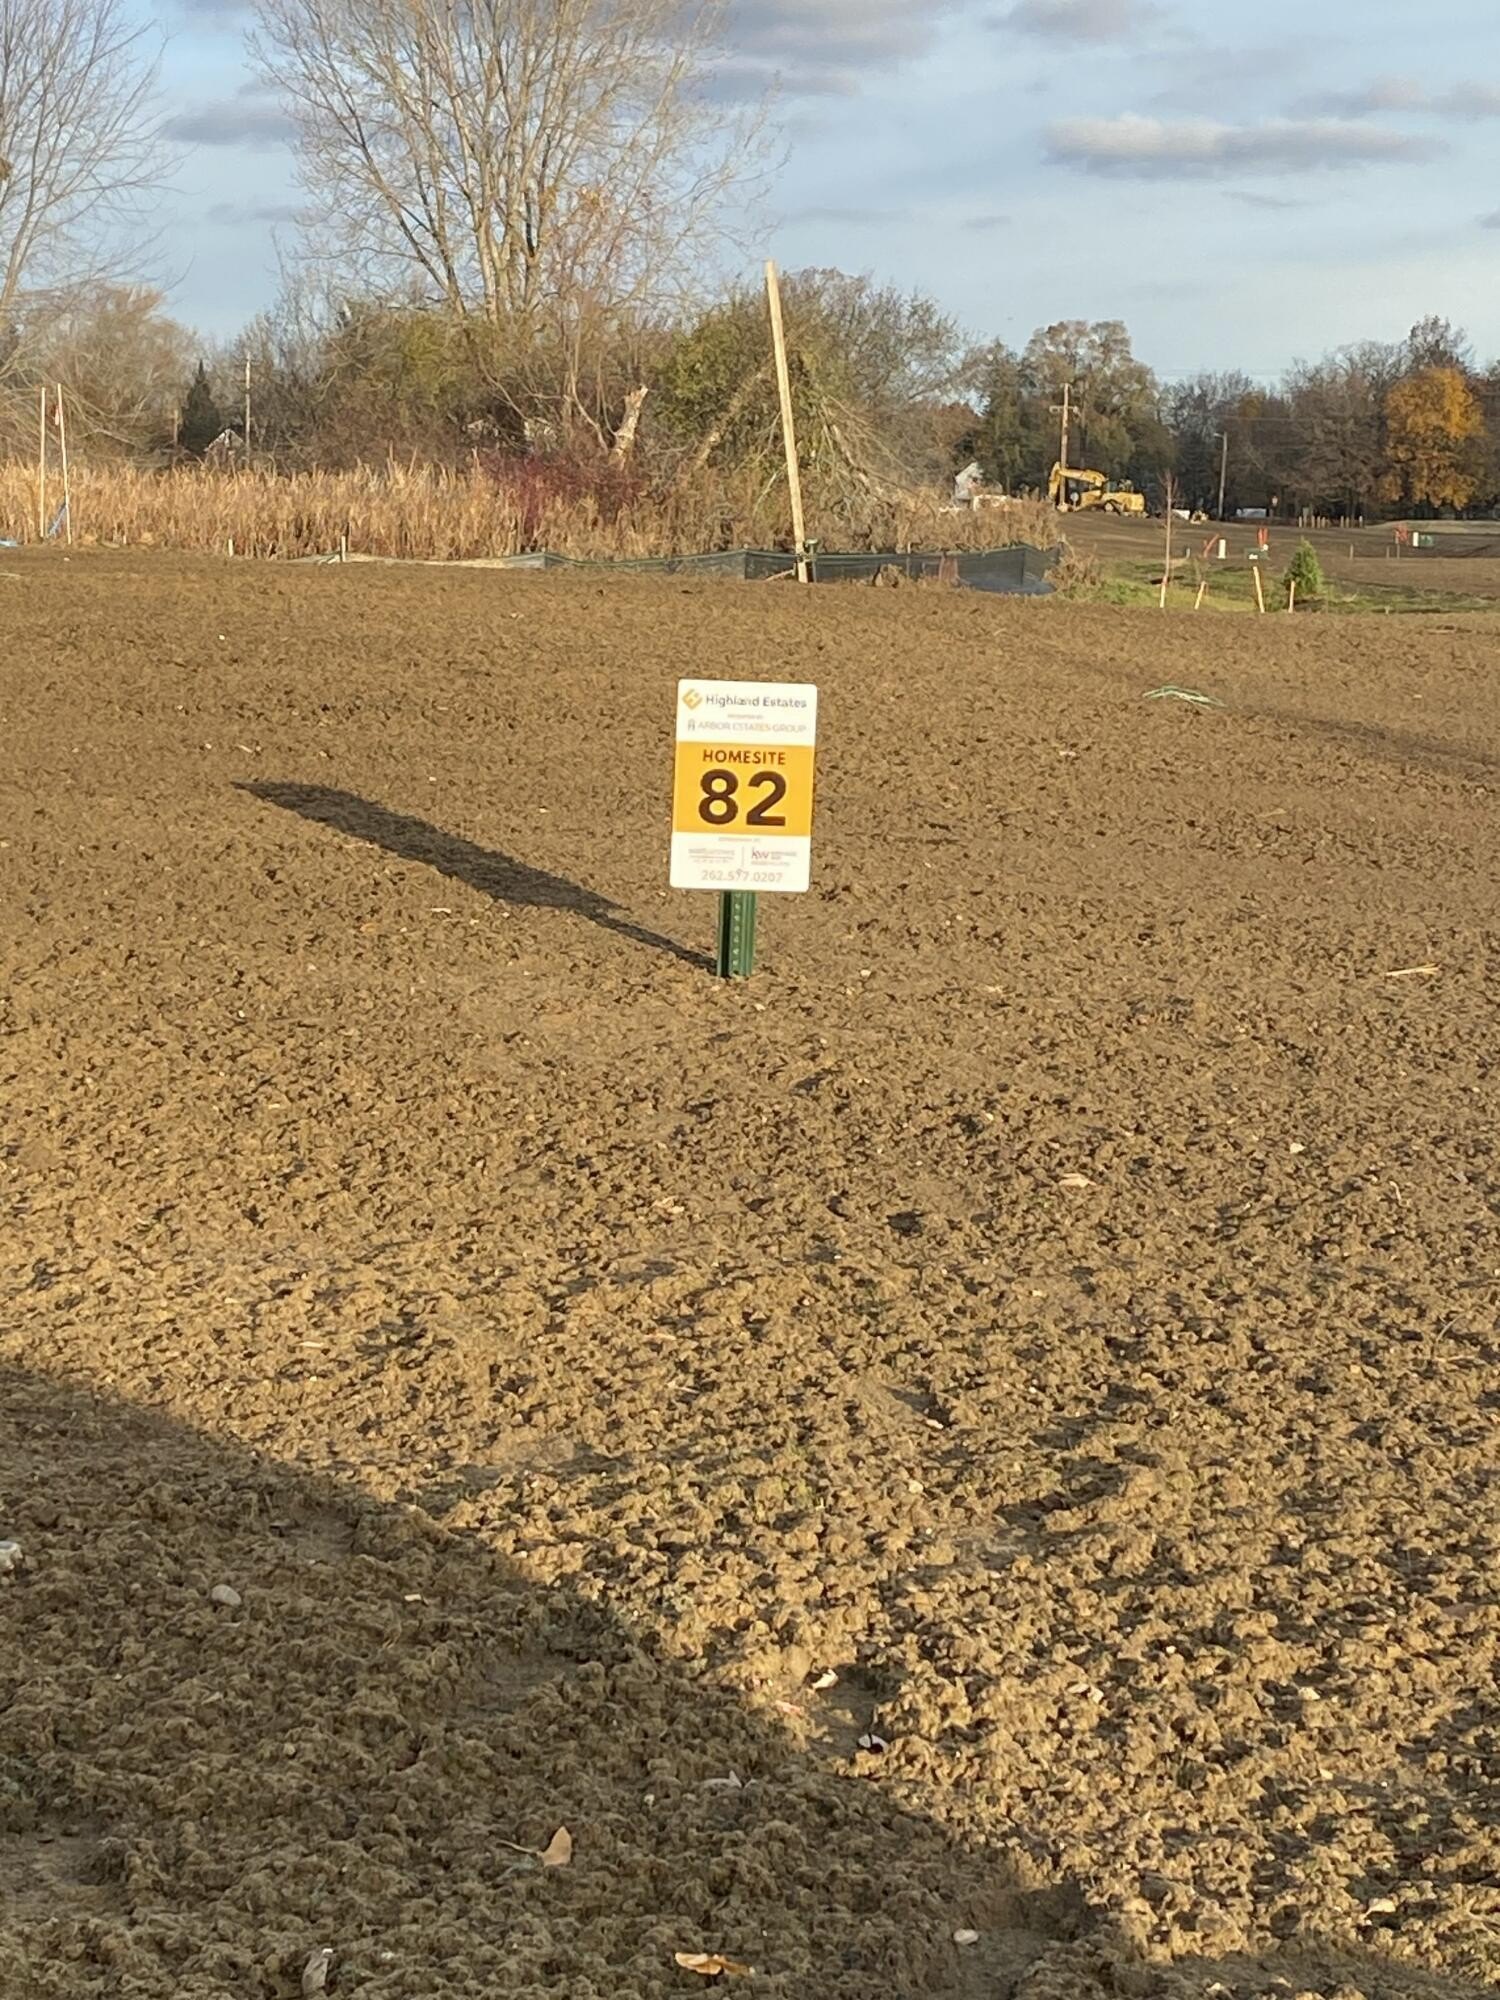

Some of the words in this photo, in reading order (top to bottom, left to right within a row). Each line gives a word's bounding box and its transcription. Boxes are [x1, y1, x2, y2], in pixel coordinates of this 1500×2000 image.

[706, 694, 760, 708] Highland
[763, 696, 808, 709] Estates
[772, 722, 807, 733] GROUP
[702, 749, 786, 765] HOMESITE
[698, 768, 787, 827] 82
